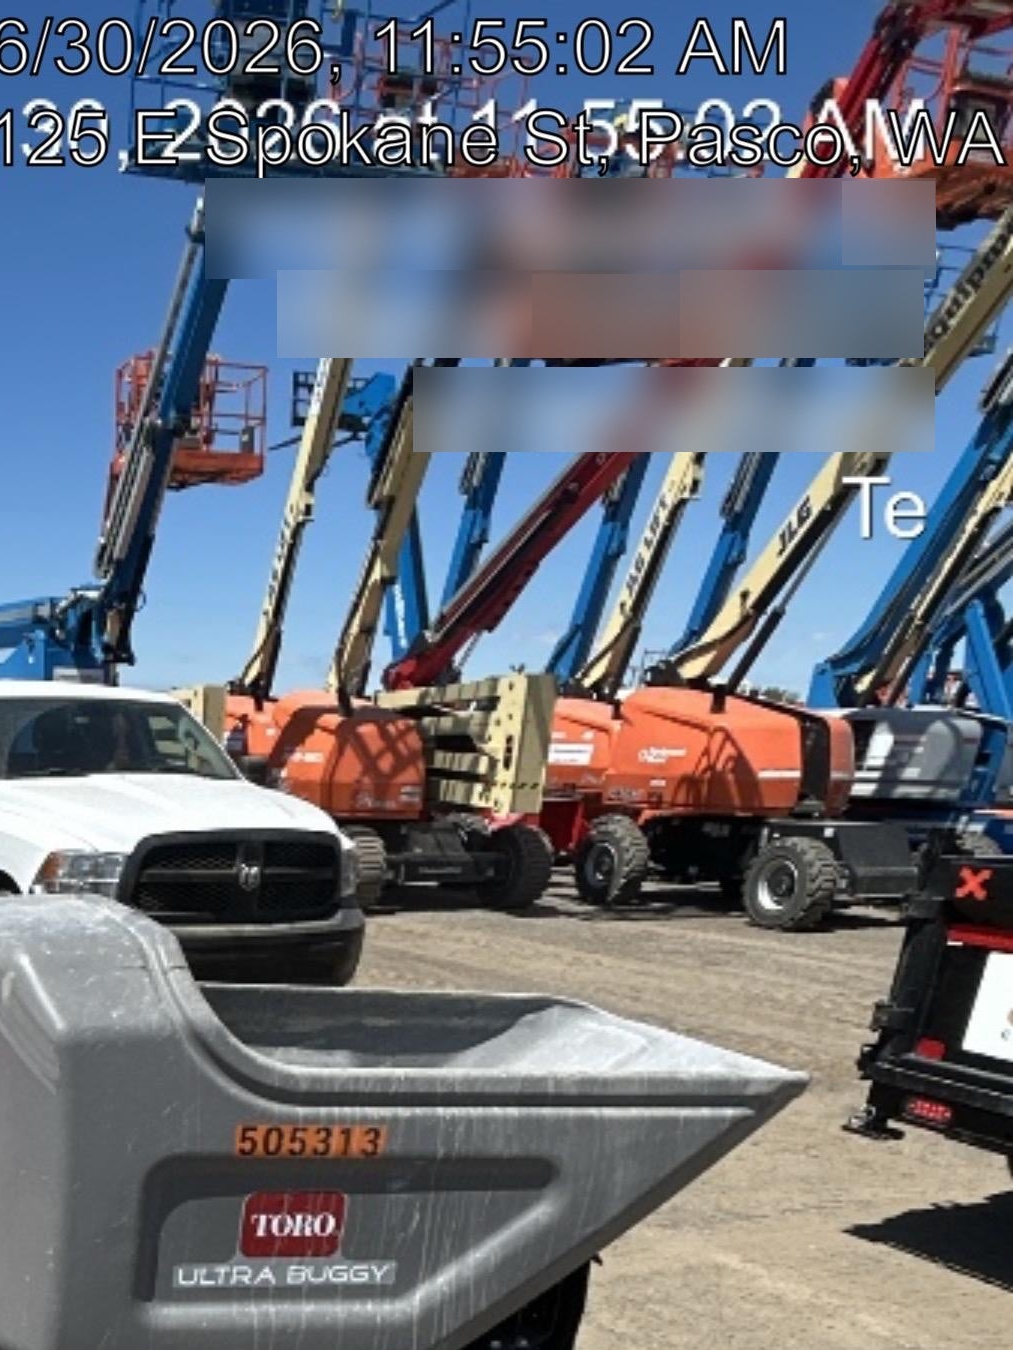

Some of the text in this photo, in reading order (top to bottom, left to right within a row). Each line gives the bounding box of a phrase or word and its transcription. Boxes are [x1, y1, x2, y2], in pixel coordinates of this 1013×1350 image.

[777, 496, 813, 556] JLG
[238, 1126, 381, 1156] 505313
[251, 1212, 337, 1237] TORO
[177, 1263, 390, 1286] ULTRA BUGGY
